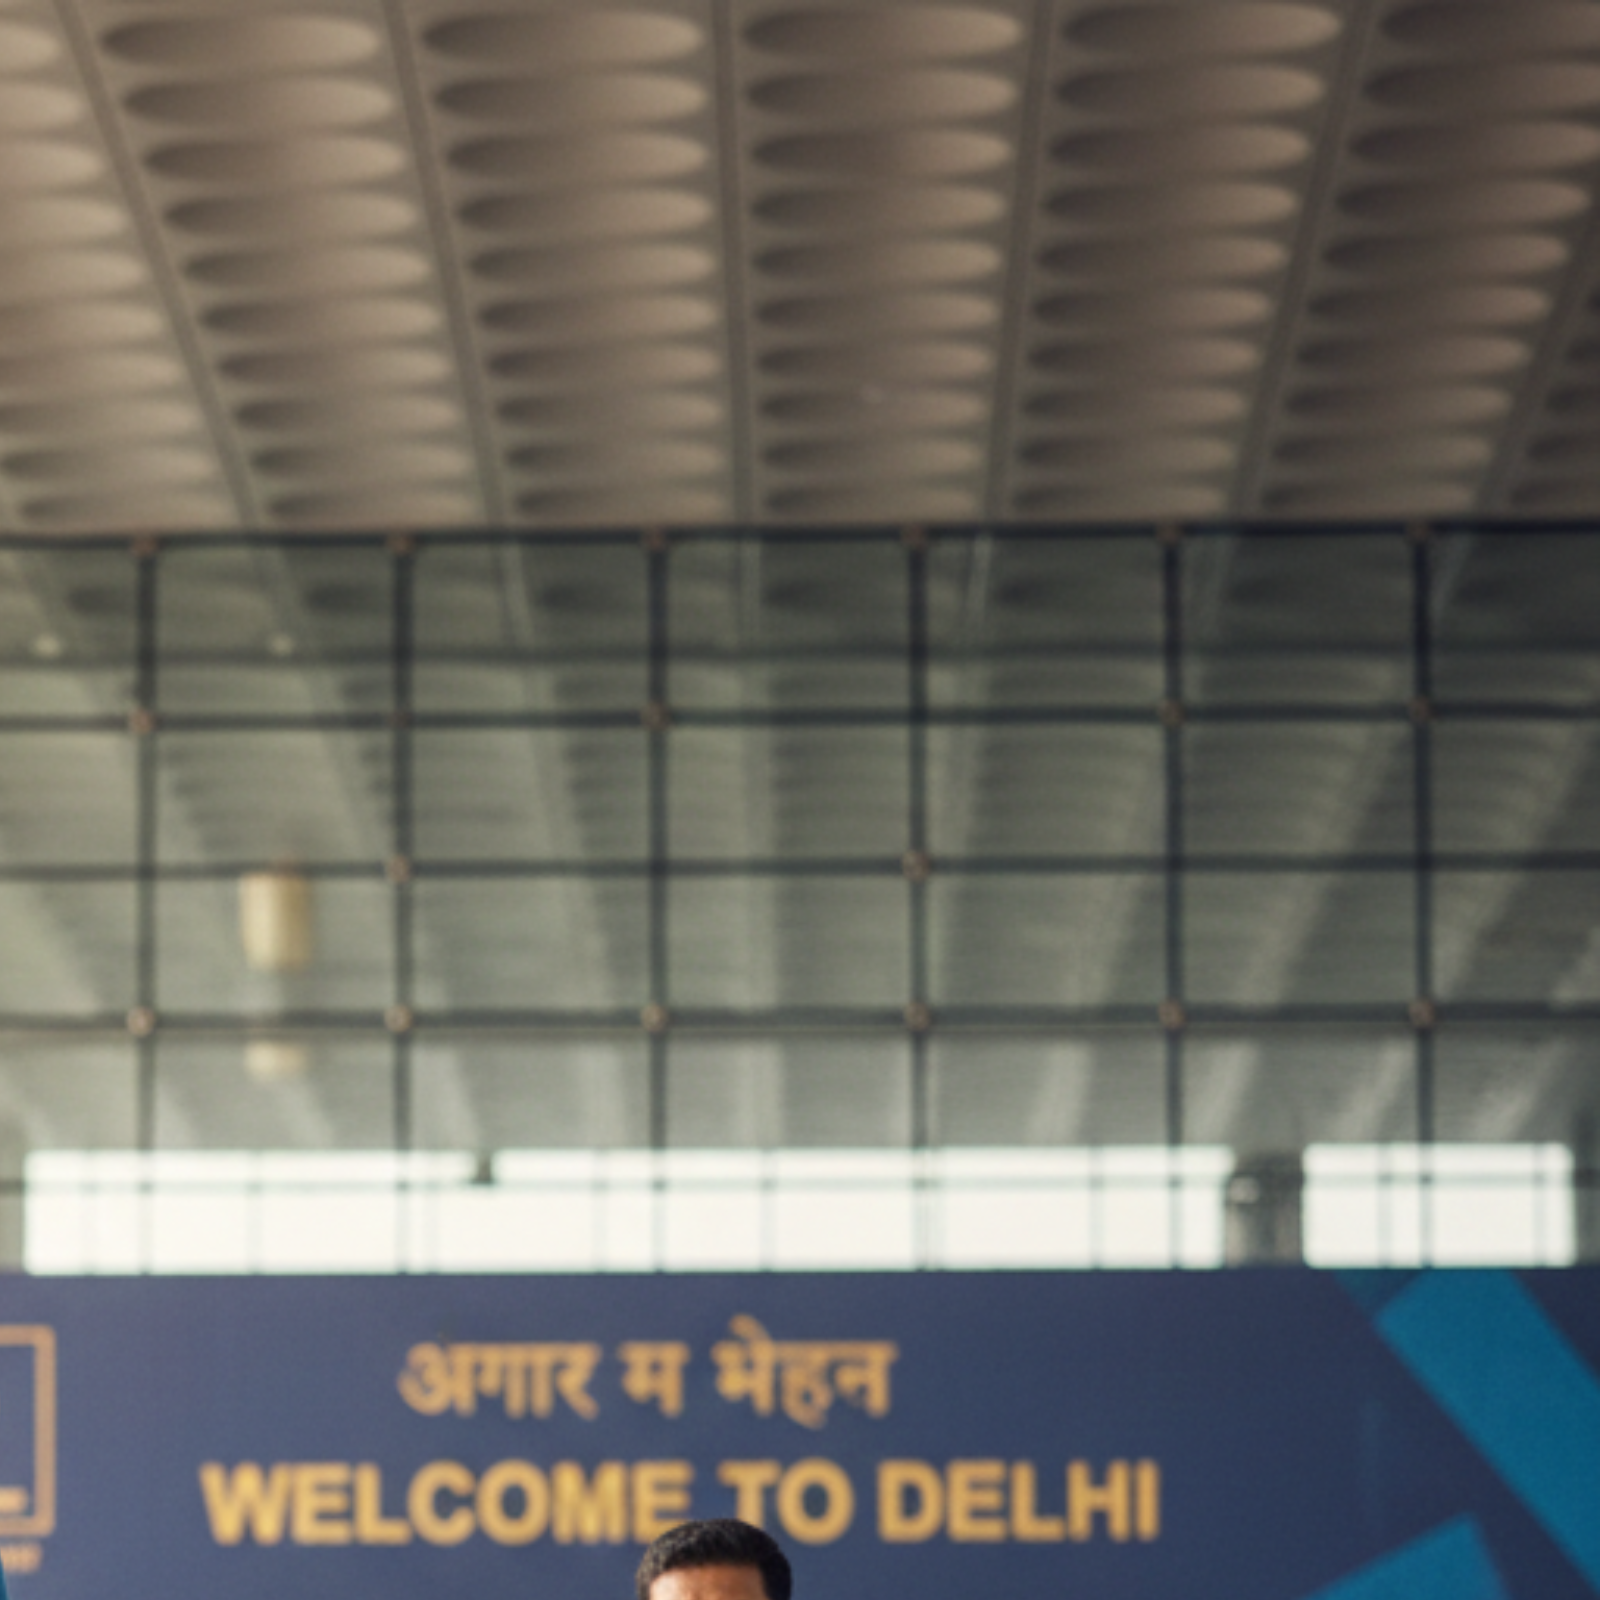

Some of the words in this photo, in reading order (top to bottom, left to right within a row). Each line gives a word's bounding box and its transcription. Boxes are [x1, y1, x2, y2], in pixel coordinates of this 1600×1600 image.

[201, 1460, 692, 1545] WELCOME
[719, 1459, 854, 1544] TO
[878, 1459, 1158, 1543] DELHI
